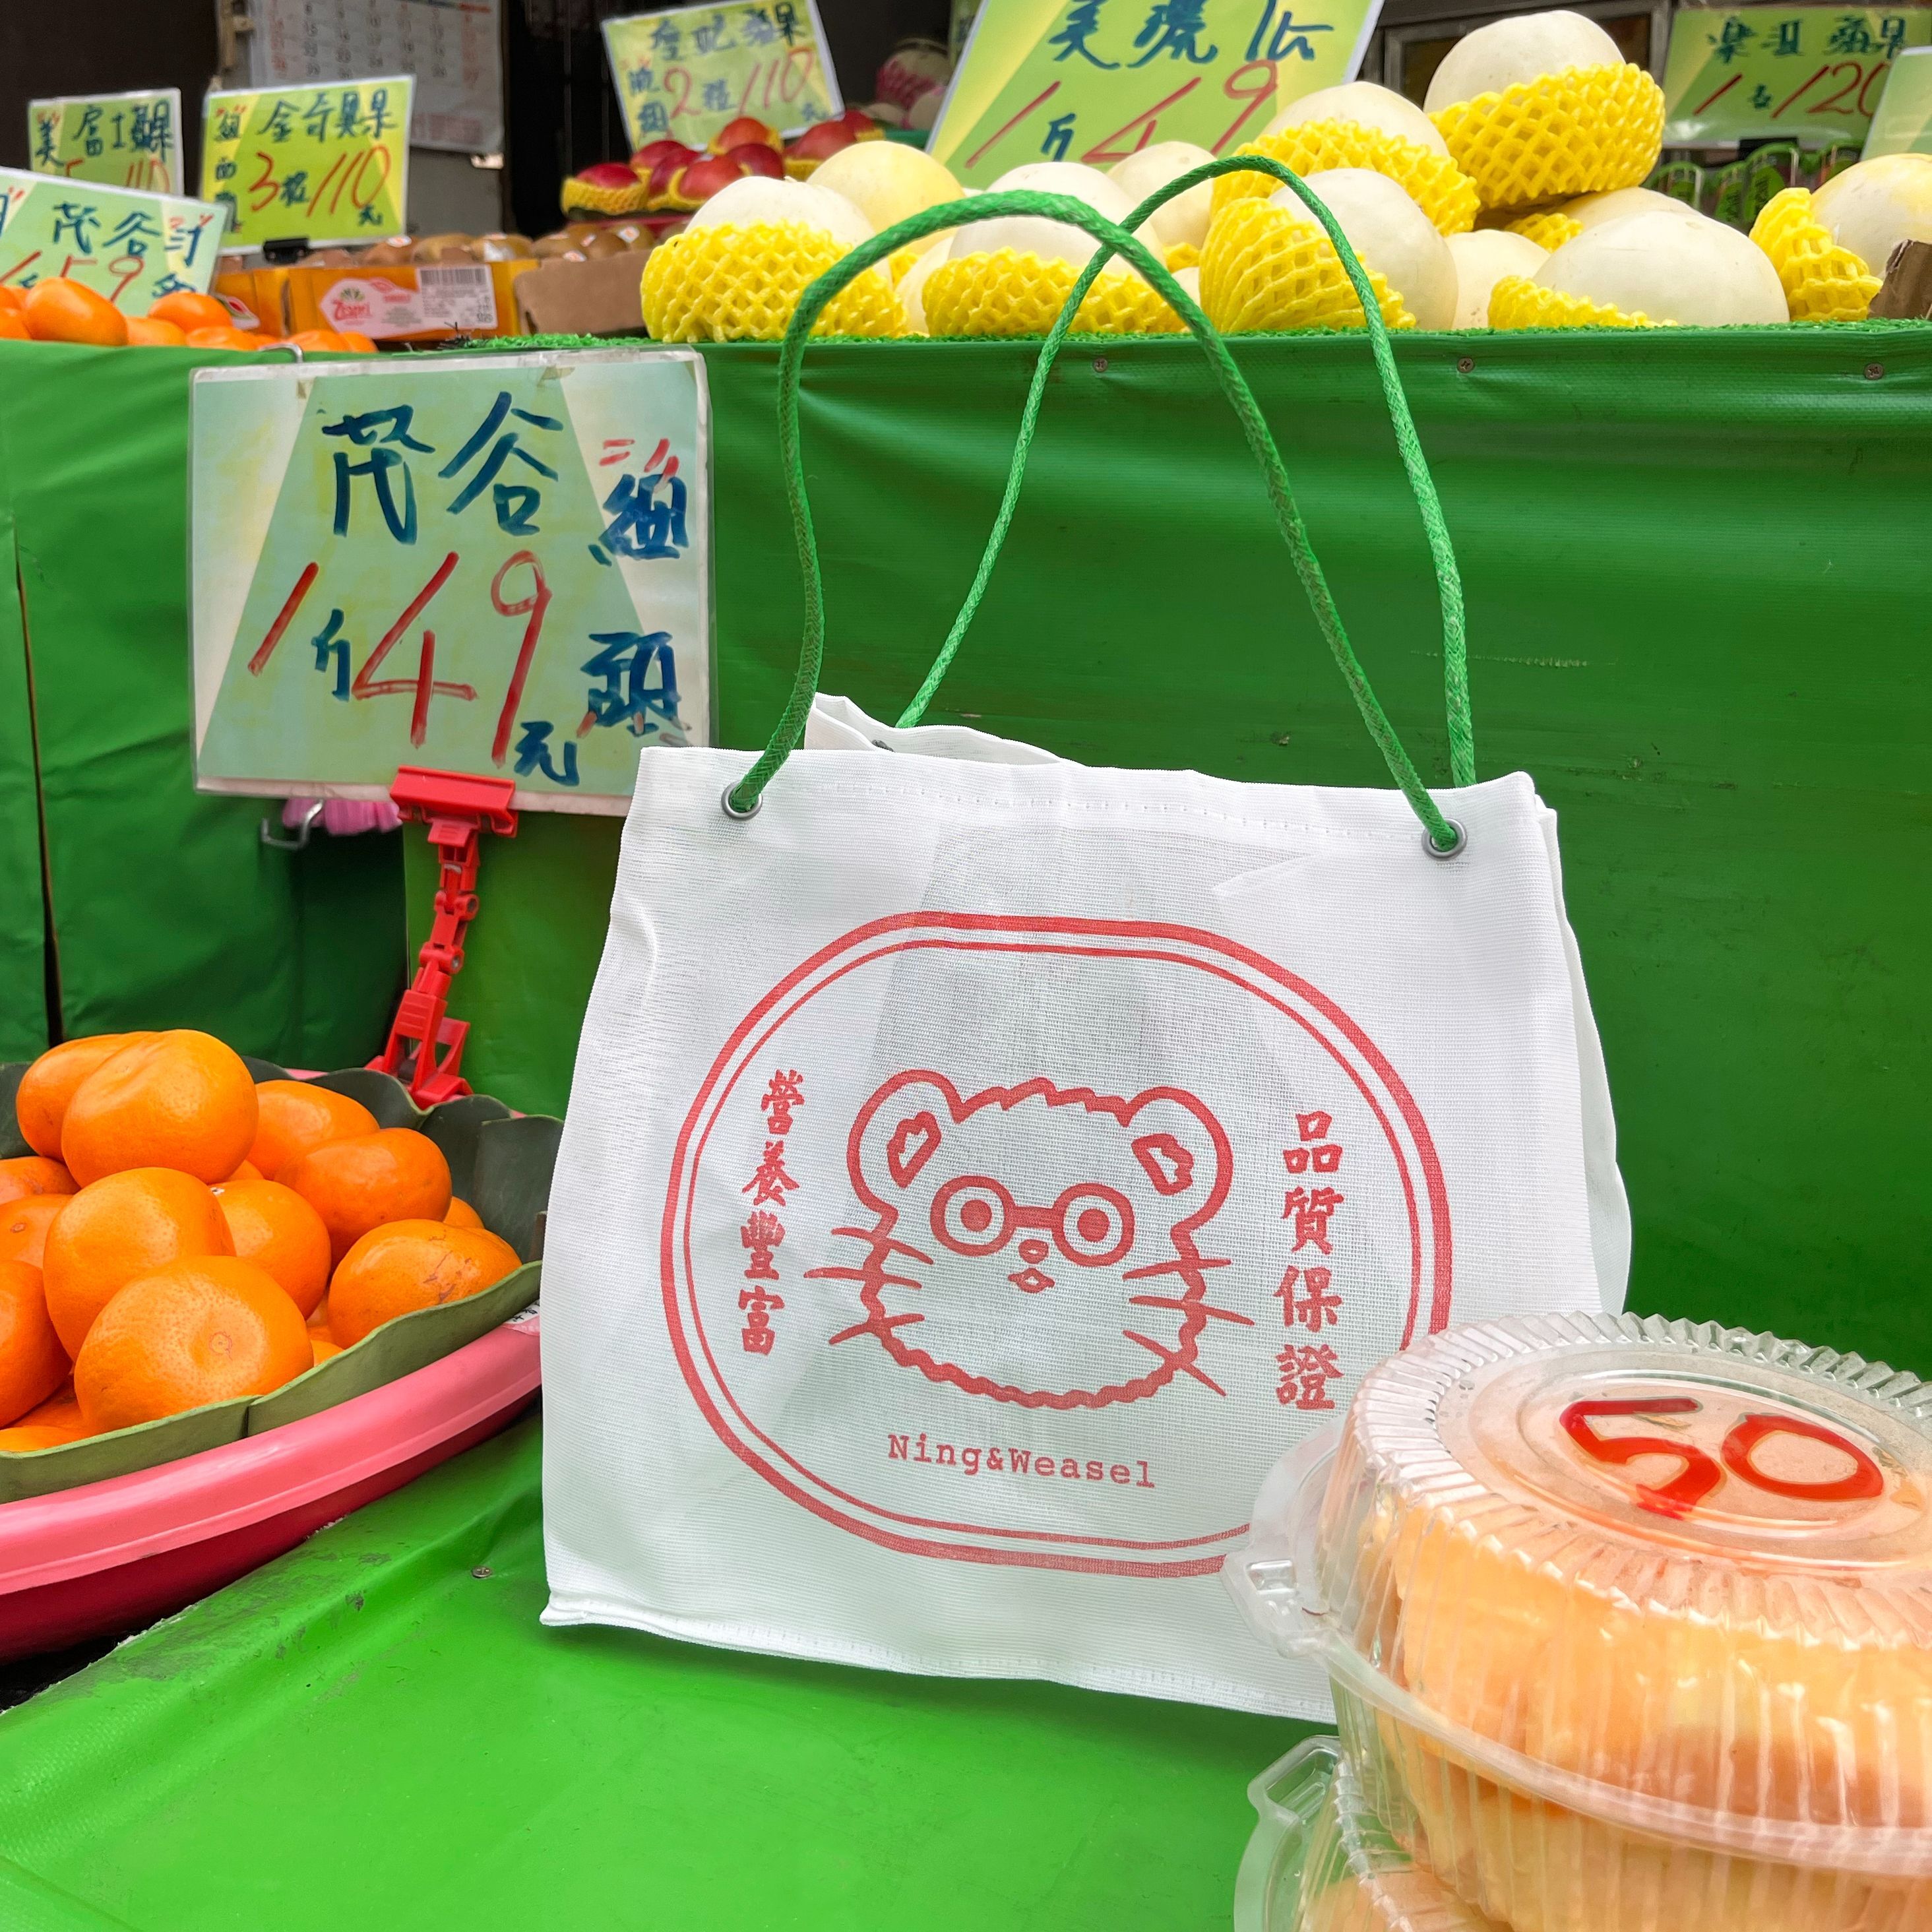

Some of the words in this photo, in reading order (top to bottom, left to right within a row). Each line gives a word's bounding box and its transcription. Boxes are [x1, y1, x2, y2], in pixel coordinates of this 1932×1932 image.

[321, 391, 564, 545] 茂谷
[1272, 1110, 1345, 1411] 品質保證
[887, 1432, 1156, 1489] Ning&Weasel
[1559, 1397, 1885, 1521] 50
